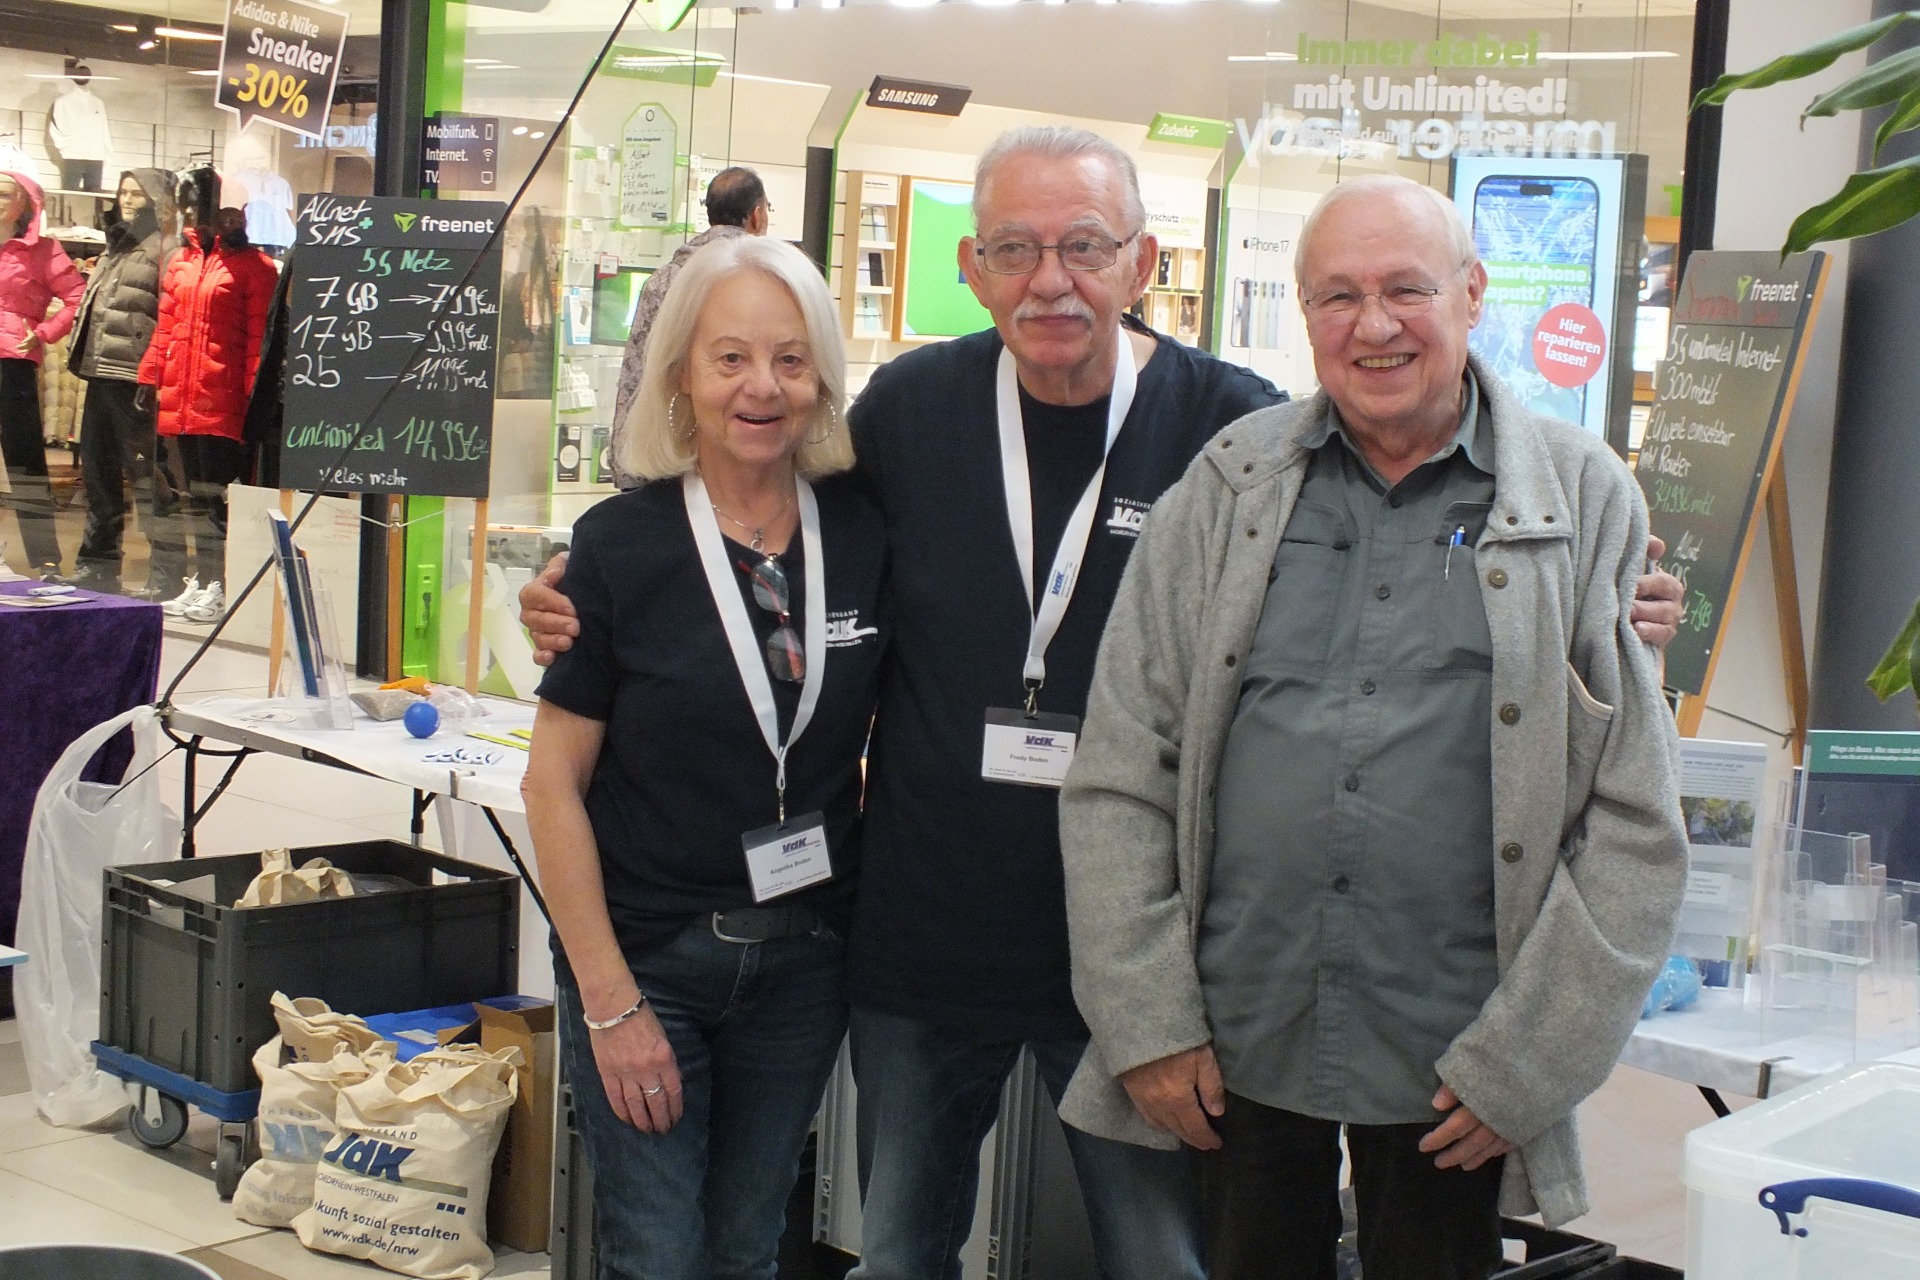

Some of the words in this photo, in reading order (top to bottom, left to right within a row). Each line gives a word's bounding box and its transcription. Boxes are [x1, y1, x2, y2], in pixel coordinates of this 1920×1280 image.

[233, 0, 277, 26] Adidas
[277, 11, 289, 29] &
[289, 14, 320, 38] Nike
[247, 27, 333, 76] Sneaker
[1297, 31, 1418, 65] Immer
[1426, 29, 1539, 67] dabei
[228, 63, 309, 118] -30%
[877, 88, 939, 107] SAMSUNG
[1293, 74, 1355, 110] mit
[1363, 75, 1567, 114] Unlimited!
[426, 123, 479, 140] Mobilfunk.
[1157, 122, 1199, 139] Zubehör
[425, 147, 469, 162] Internet.
[297, 194, 372, 224] Allnet
[305, 222, 362, 246] SMS
[421, 215, 495, 234] freenet
[1250, 237, 1279, 252] iPhone
[1281, 240, 1289, 252] 17
[400, 248, 454, 273] Netz
[1486, 264, 1588, 284] martphone
[308, 276, 341, 309] 7
[1484, 285, 1546, 303] aputt?
[1750, 278, 1799, 302] freenet
[293, 314, 339, 352] 17
[1559, 317, 1587, 335] Hier
[1537, 330, 1601, 355] reparieren
[1545, 346, 1588, 368] lassen!
[292, 353, 341, 389] 25
[782, 837, 807, 855] VdK
[316, 1173, 399, 1203] ORDRHEIN-WESTFALEN
[353, 1213, 387, 1229] sozial
[390, 1224, 460, 1241] gestalten
[322, 1226, 420, 1256] www.vdk.de/nrw
